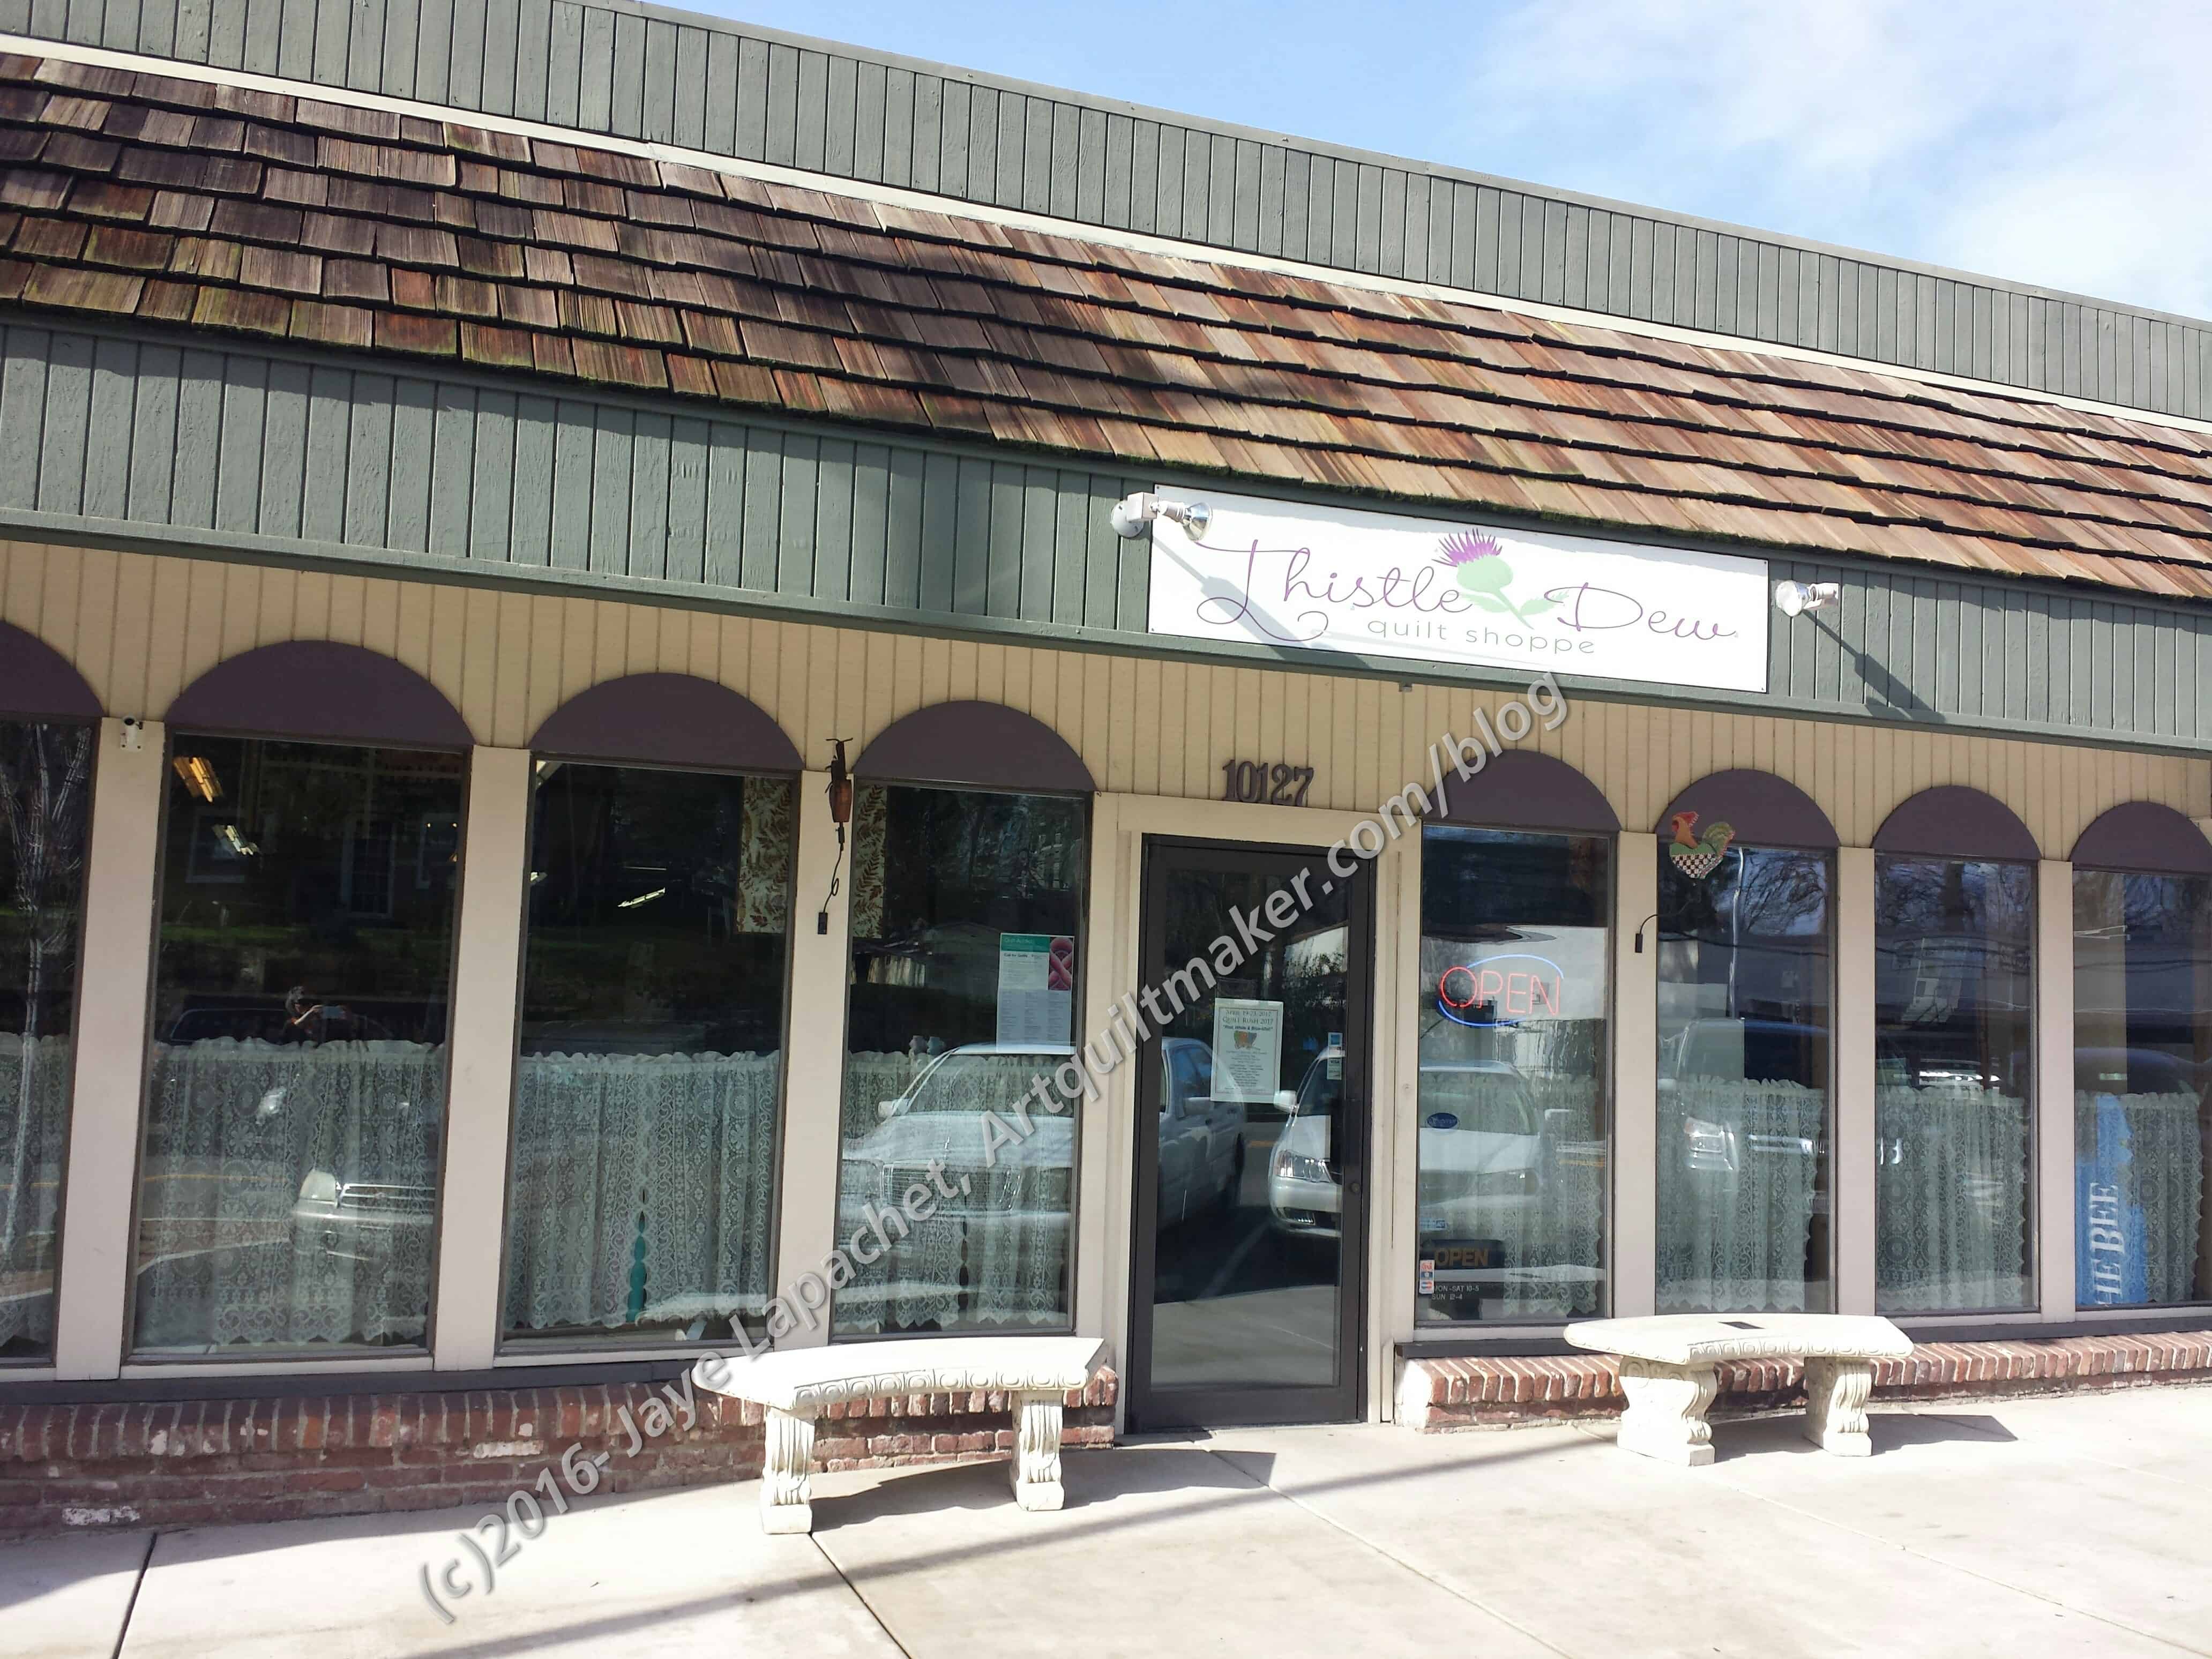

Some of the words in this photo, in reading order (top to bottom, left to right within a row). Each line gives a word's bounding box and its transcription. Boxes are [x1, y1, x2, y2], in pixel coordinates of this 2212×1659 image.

[1194, 539, 1473, 642] Thistle
[1544, 582, 1737, 640] Dew
[1367, 620, 1447, 640] quilt
[1466, 627, 1594, 654] shoppe
[1222, 759, 1314, 806] 10127
[1440, 966, 1561, 1015] OPEN
[2090, 1182, 2127, 1256] BEE
[1434, 1247, 1489, 1267] OPEN
